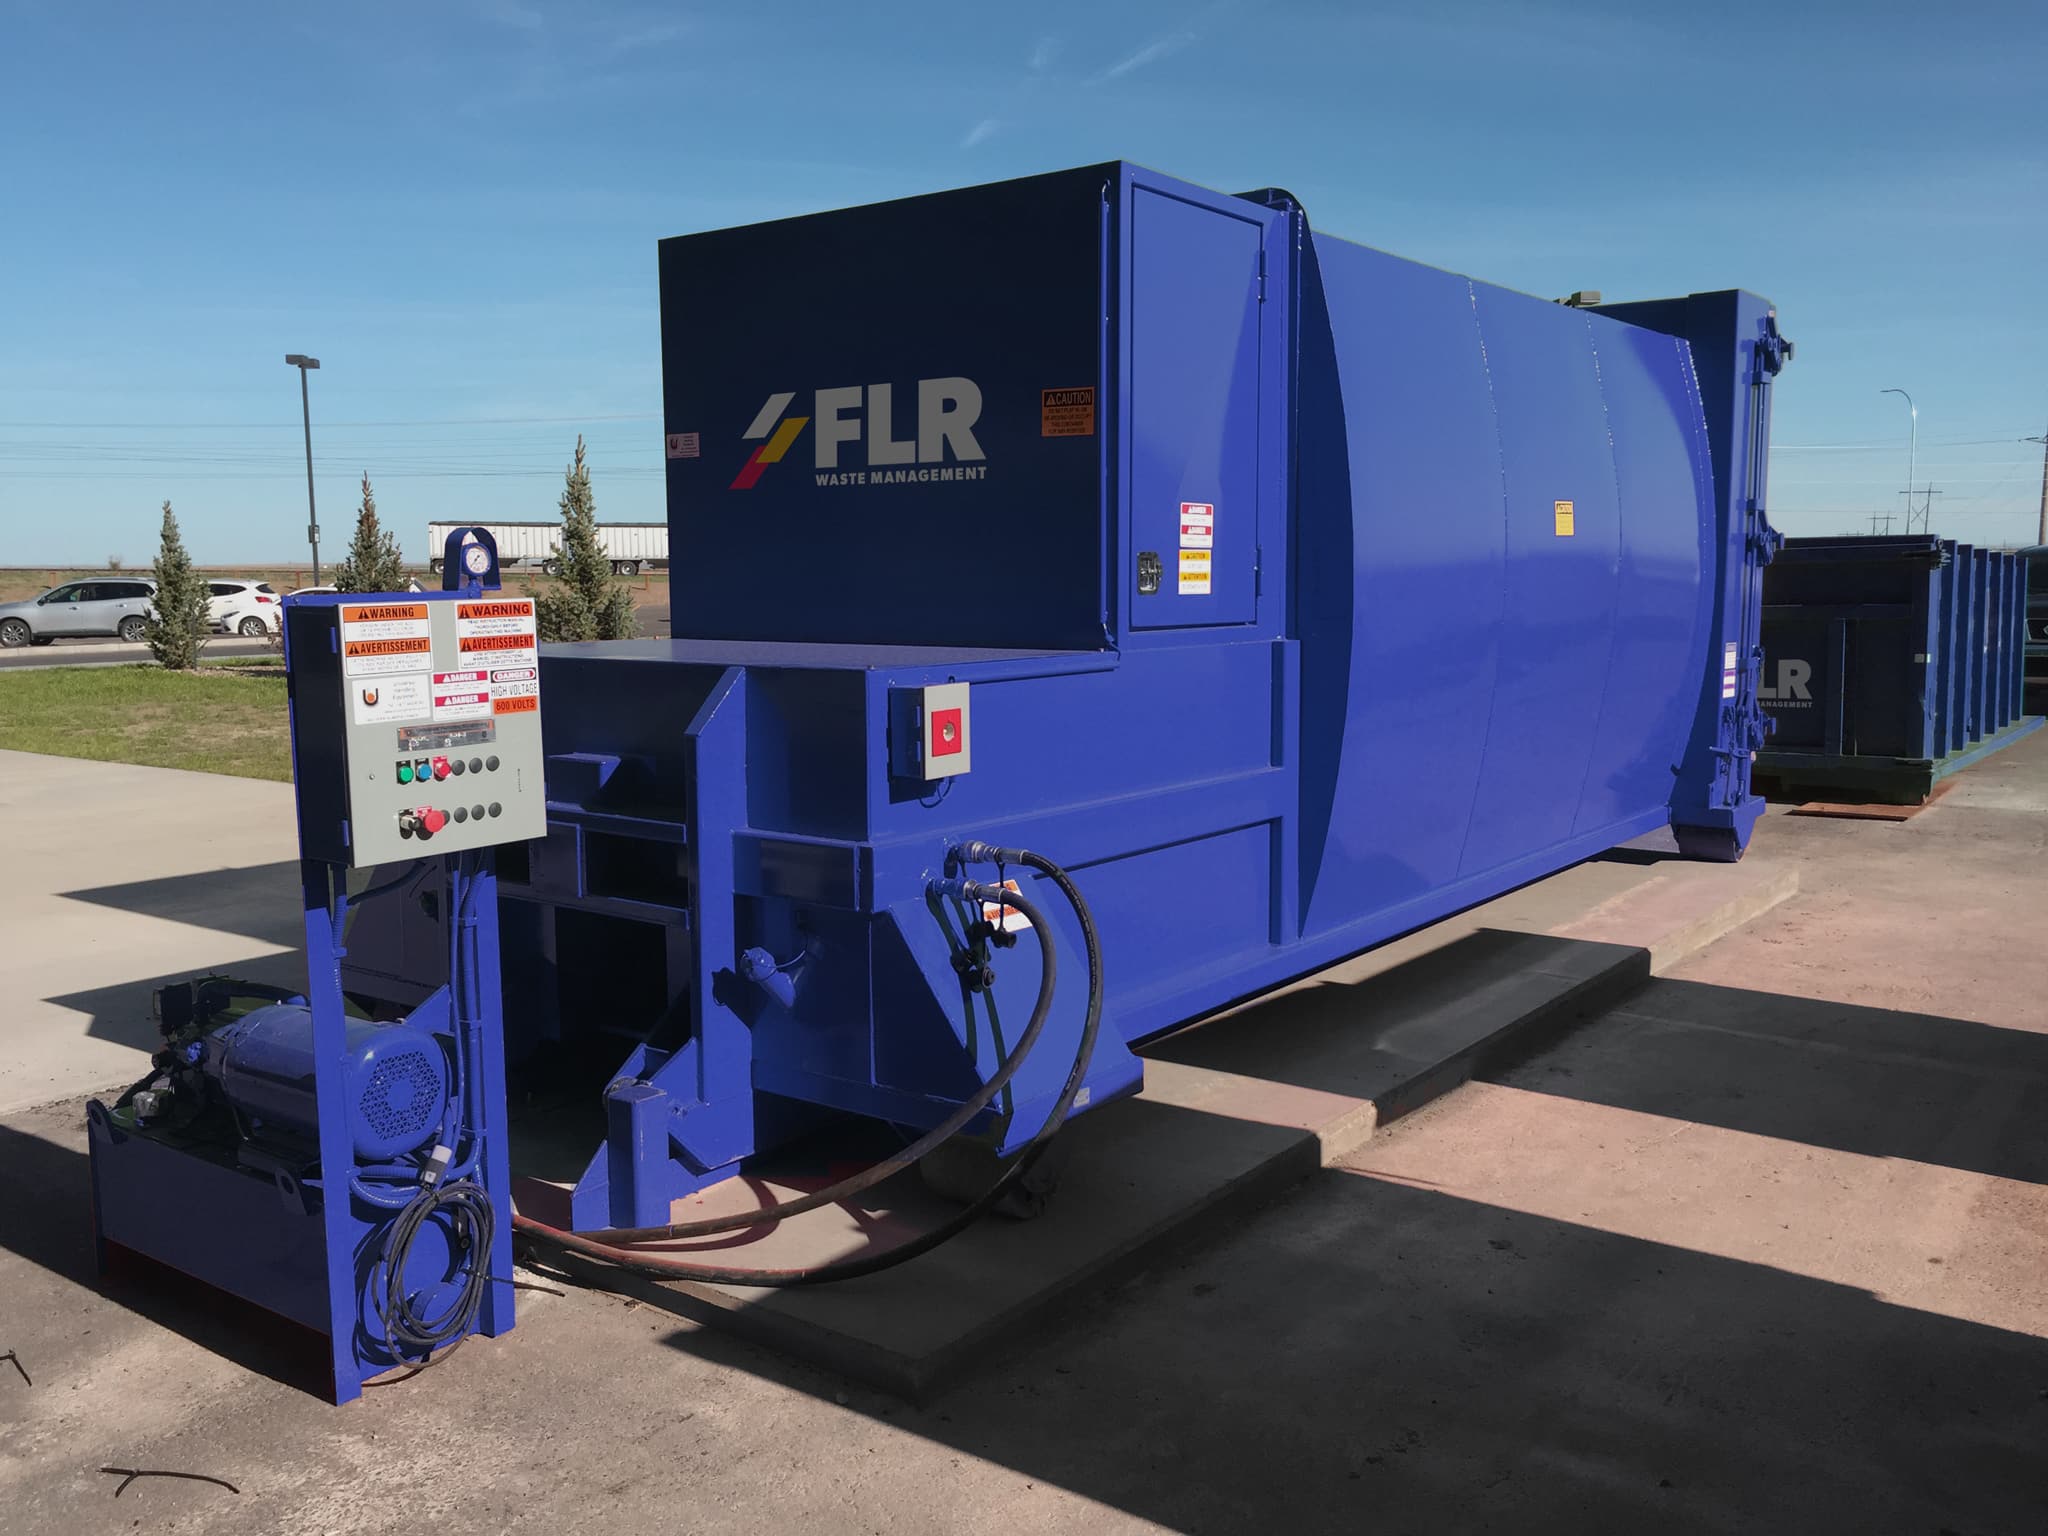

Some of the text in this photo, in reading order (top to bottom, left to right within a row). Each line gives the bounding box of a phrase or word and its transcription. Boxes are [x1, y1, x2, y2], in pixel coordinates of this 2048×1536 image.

[1056, 391, 1092, 405] CAUTION
[815, 376, 987, 469] FLR
[815, 466, 988, 487] WASTE MANAGEMENT
[369, 606, 415, 619] WARNING
[472, 604, 530, 617] WARNING
[360, 639, 428, 654] AVERTISSEMENT
[472, 635, 534, 650] AVERTISSEMENT
[450, 672, 478, 682] DANGER
[1757, 659, 1812, 699] LR
[491, 685, 508, 697] HIGH
[509, 682, 538, 695] VOLTAGE
[495, 700, 511, 711] 600
[511, 698, 536, 710] VOLTS
